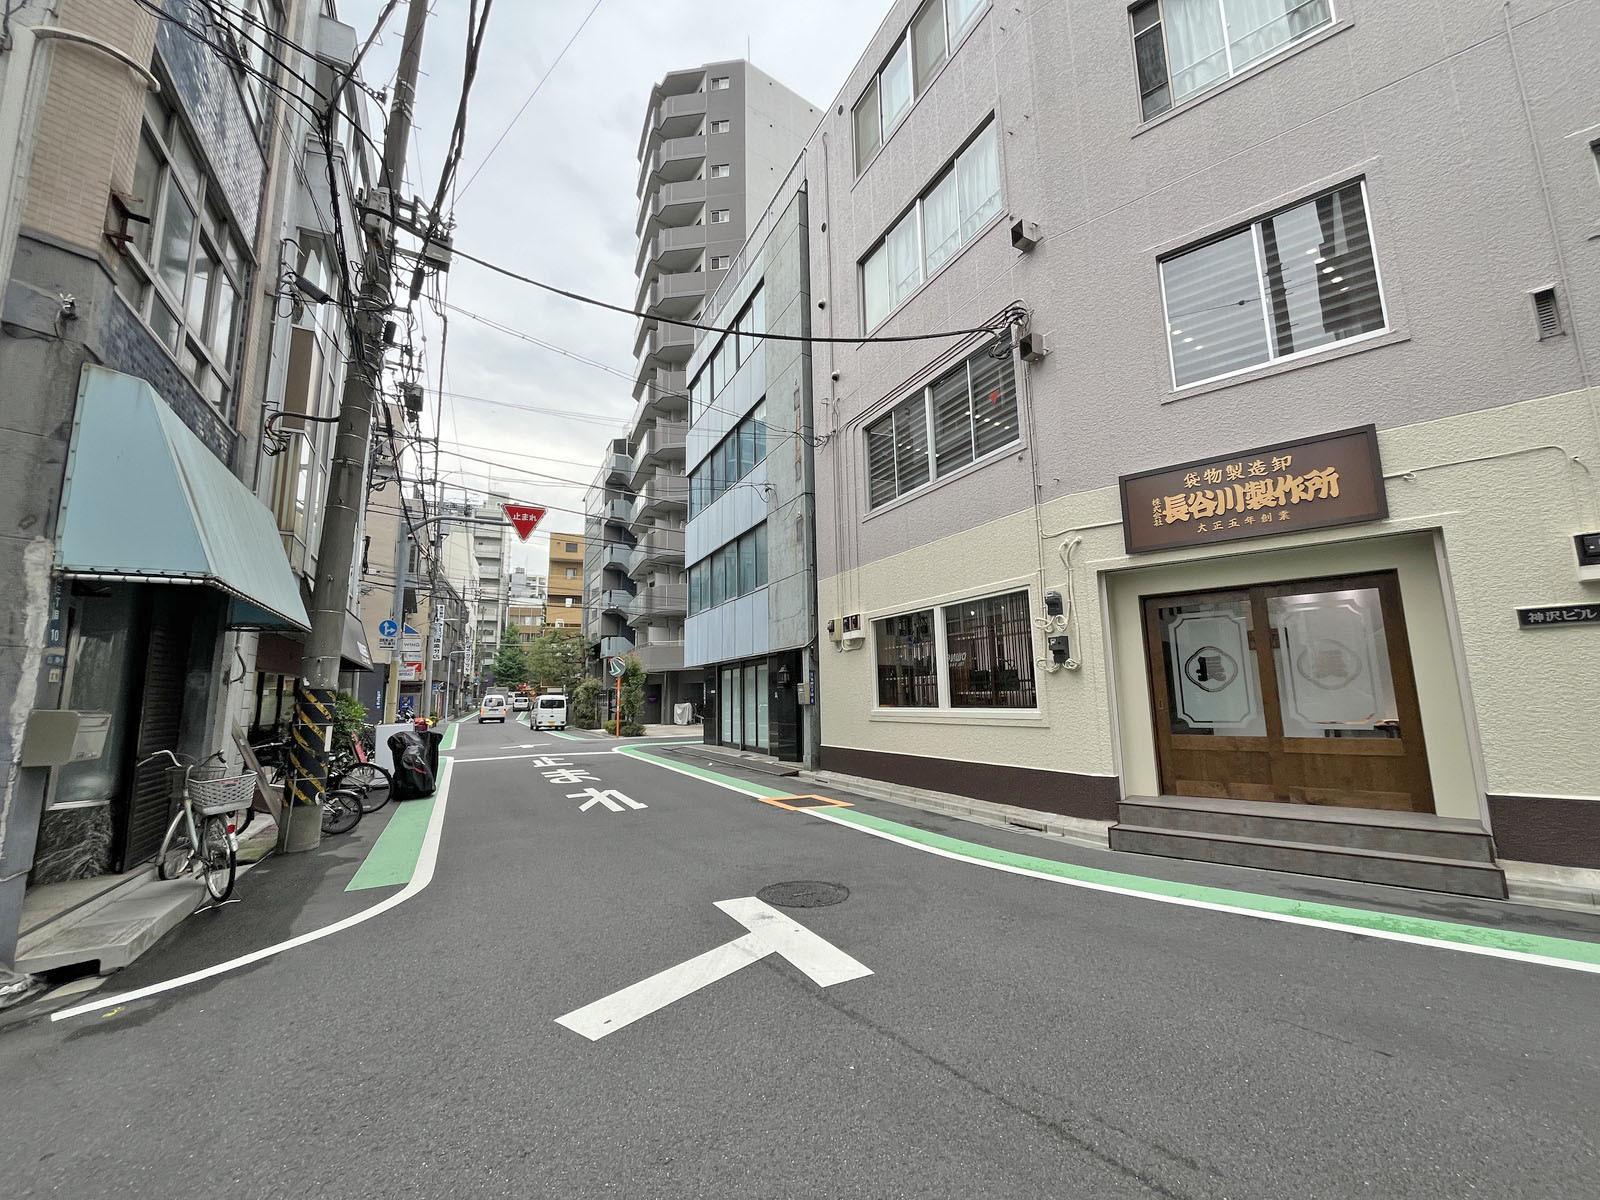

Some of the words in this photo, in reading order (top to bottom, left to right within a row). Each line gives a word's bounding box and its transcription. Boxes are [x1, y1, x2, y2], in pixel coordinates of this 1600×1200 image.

[1184, 455, 1292, 489] 袋物製造卸
[1163, 466, 1340, 524] 長谷川製作所
[513, 512, 538, 522] 止まれ
[1152, 498, 1164, 527] 株式会社
[1196, 510, 1291, 533] 大正五年創業
[1527, 608, 1598, 623] 神沢ビル
[51, 629, 60, 642] 10
[532, 756, 649, 813] 止まれ
